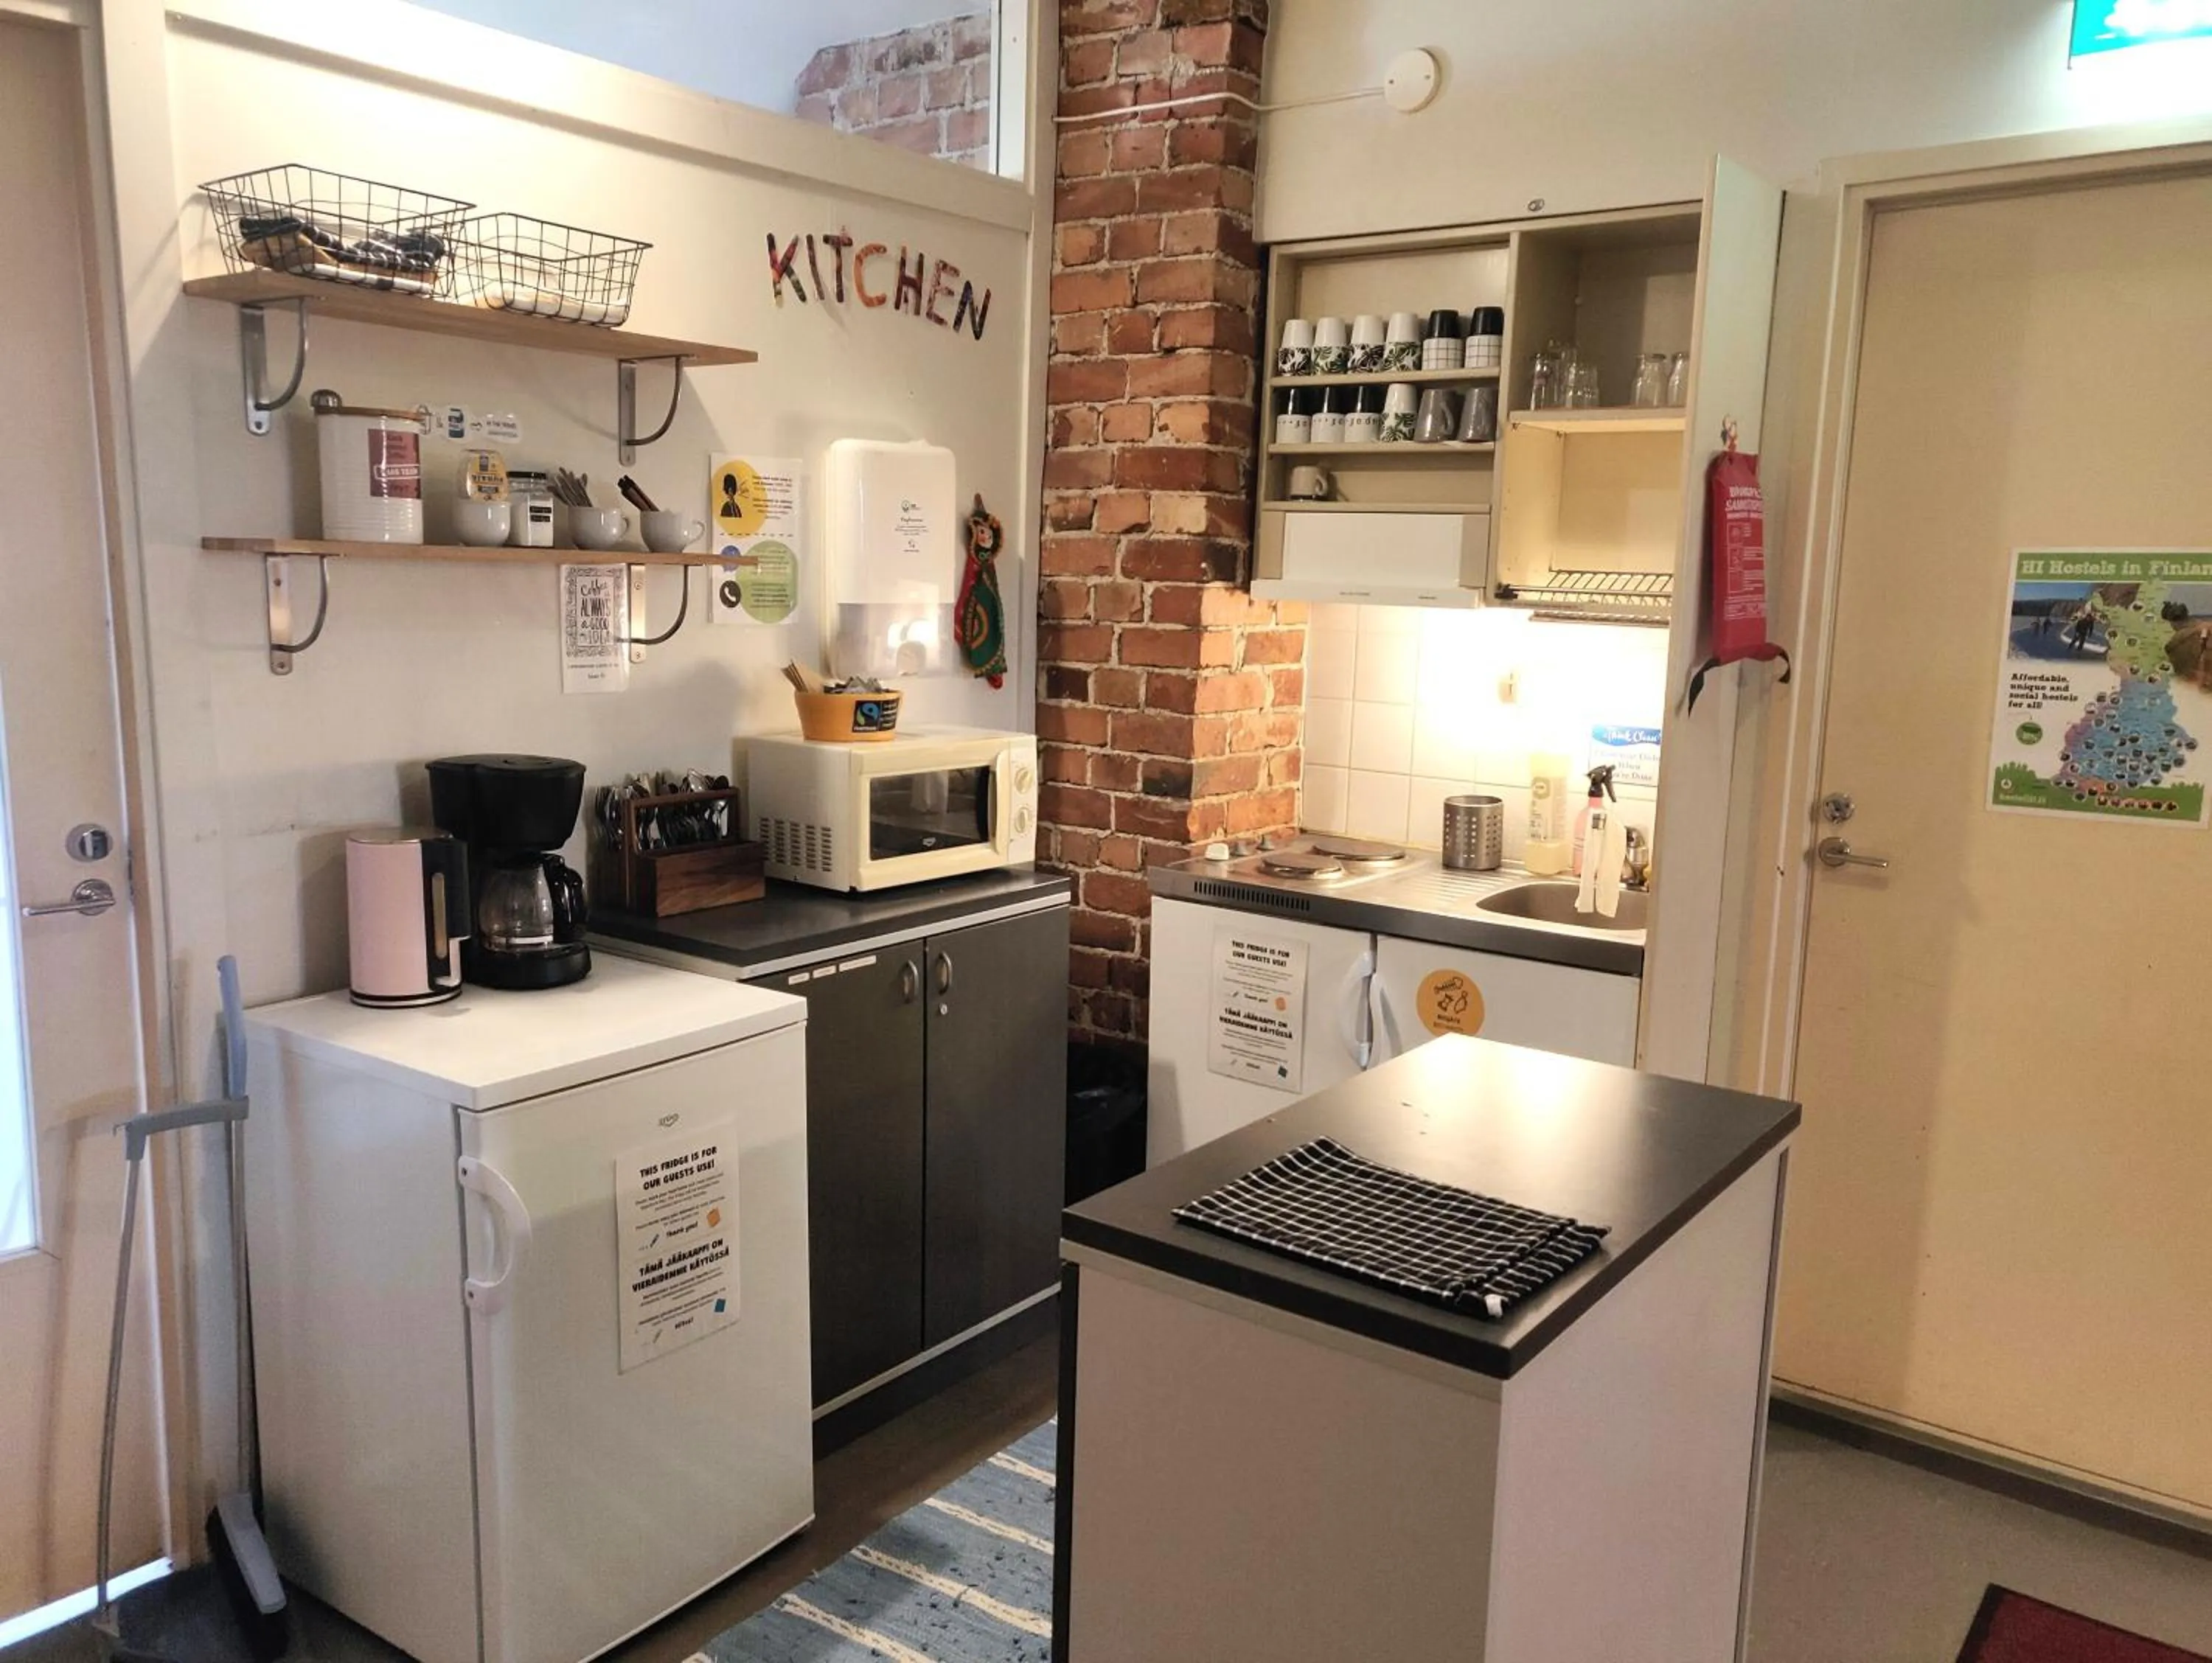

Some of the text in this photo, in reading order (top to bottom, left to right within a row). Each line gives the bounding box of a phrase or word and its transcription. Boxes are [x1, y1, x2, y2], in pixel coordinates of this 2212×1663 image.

[766, 226, 992, 341] KITCHEN
[2022, 560, 2044, 574] HI
[2049, 560, 2116, 575] Hostels
[2121, 561, 2141, 575] in
[580, 598, 611, 617] ALWAYS
[2011, 673, 2070, 683] Affordable,
[2009, 683, 2070, 693] unique and
[2042, 693, 2079, 702] hostels
[2008, 700, 2023, 708] for
[639, 1146, 717, 1178] THIS FRIDGE IS FOR
[643, 1159, 715, 1190] OUR GUESTS USE!
[639, 1258, 663, 1276] TÄMÄ
[711, 1238, 723, 1249] ON
[689, 1245, 729, 1270] KÄYTÖSSÄ
